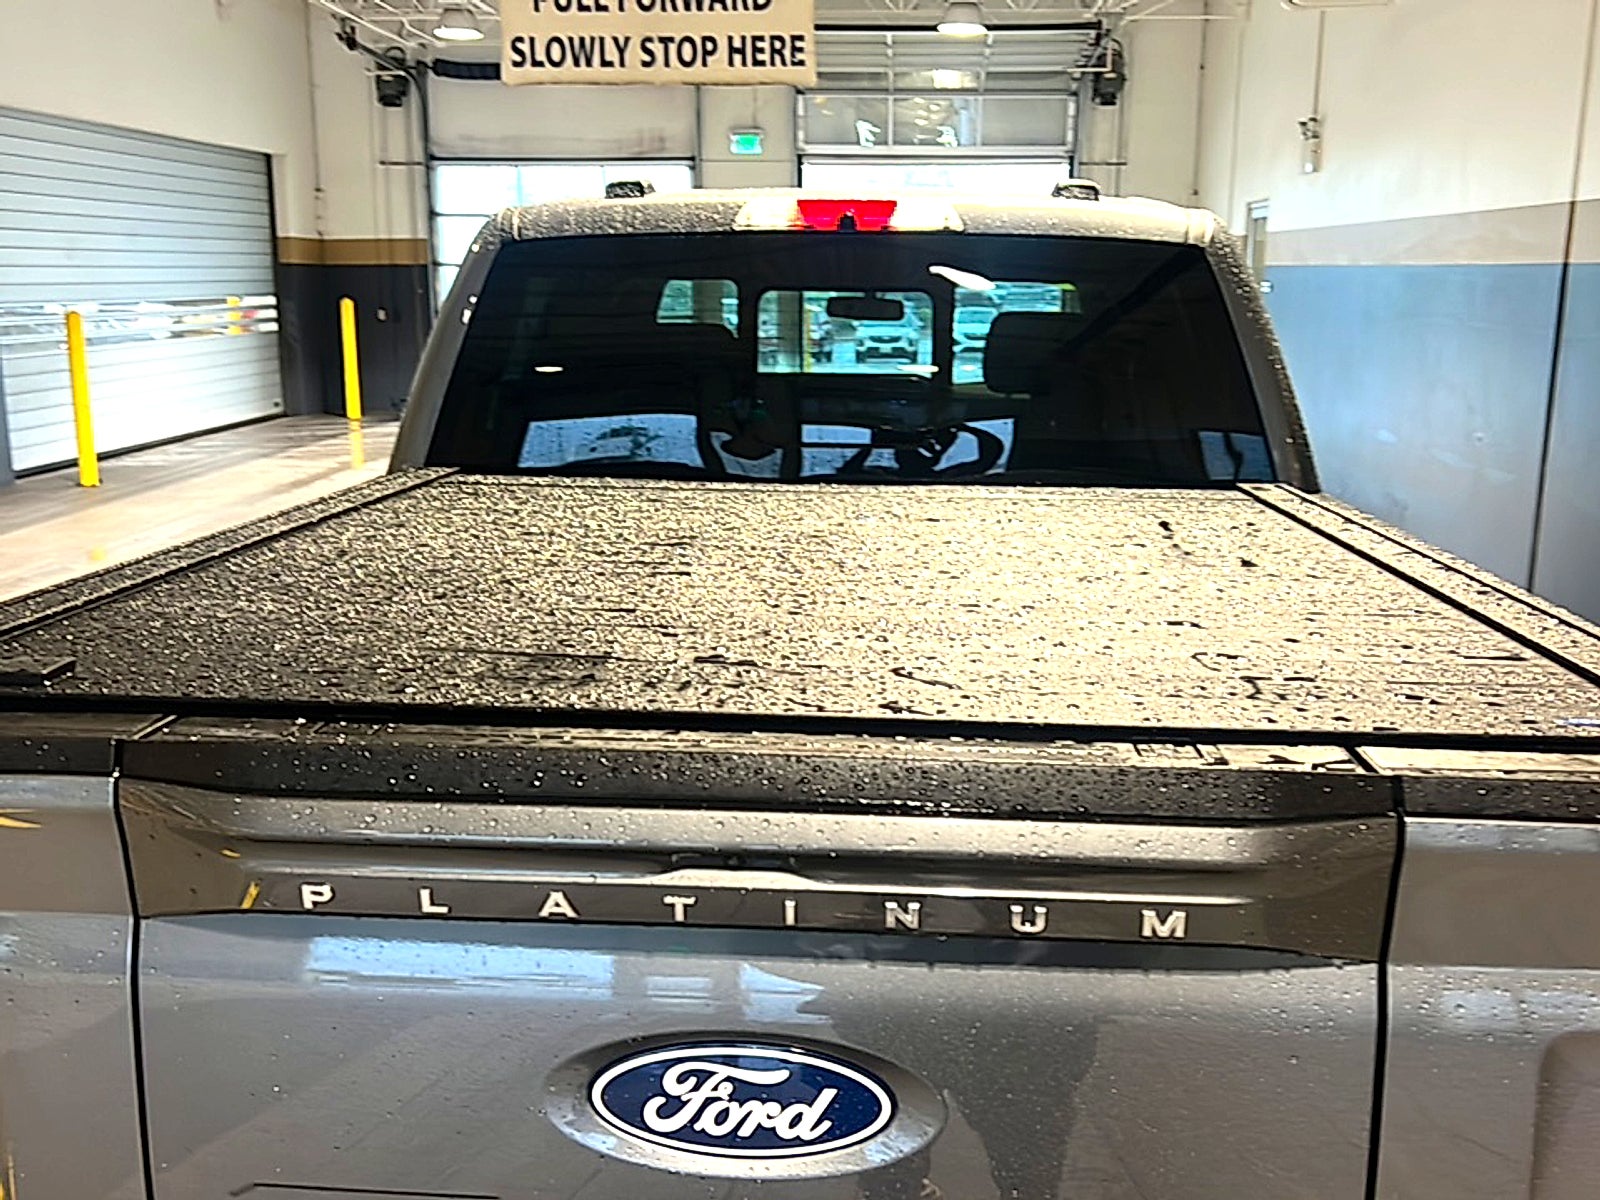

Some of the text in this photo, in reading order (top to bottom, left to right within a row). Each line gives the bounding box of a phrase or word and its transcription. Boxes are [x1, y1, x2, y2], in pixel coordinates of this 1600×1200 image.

[510, 34, 806, 68] SLOWLY STOP HERE
[301, 883, 1188, 939] PLATINUM
[643, 1061, 838, 1140] Ford
